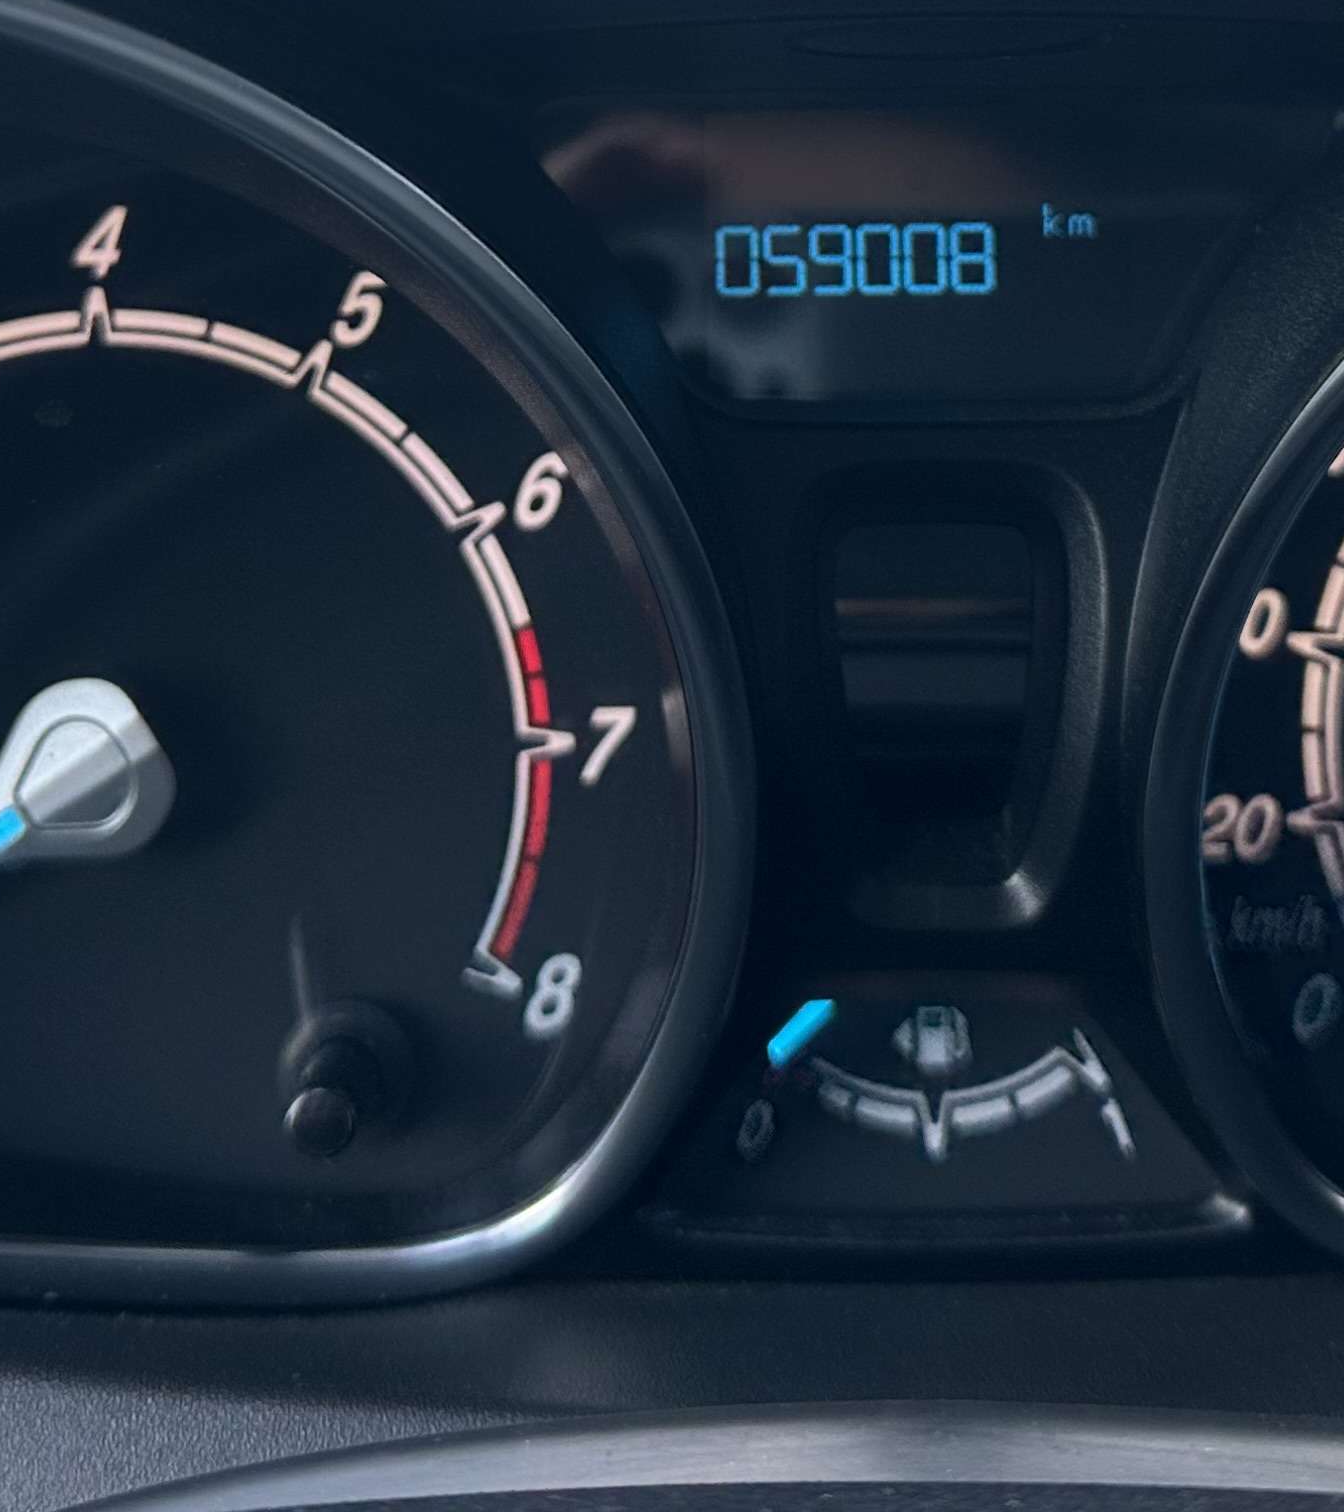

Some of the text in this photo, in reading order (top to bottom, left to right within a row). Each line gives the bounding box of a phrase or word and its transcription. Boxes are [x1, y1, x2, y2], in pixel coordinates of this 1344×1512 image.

[73, 205, 130, 278] 4
[715, 203, 1098, 297] 059008 km
[333, 271, 387, 347] 5
[513, 450, 570, 532] 6
[578, 705, 637, 785] 7
[1202, 791, 1284, 864] 20
[525, 951, 583, 1040] 8
[1292, 971, 1343, 1048] 0
[737, 1098, 776, 1160] 0
